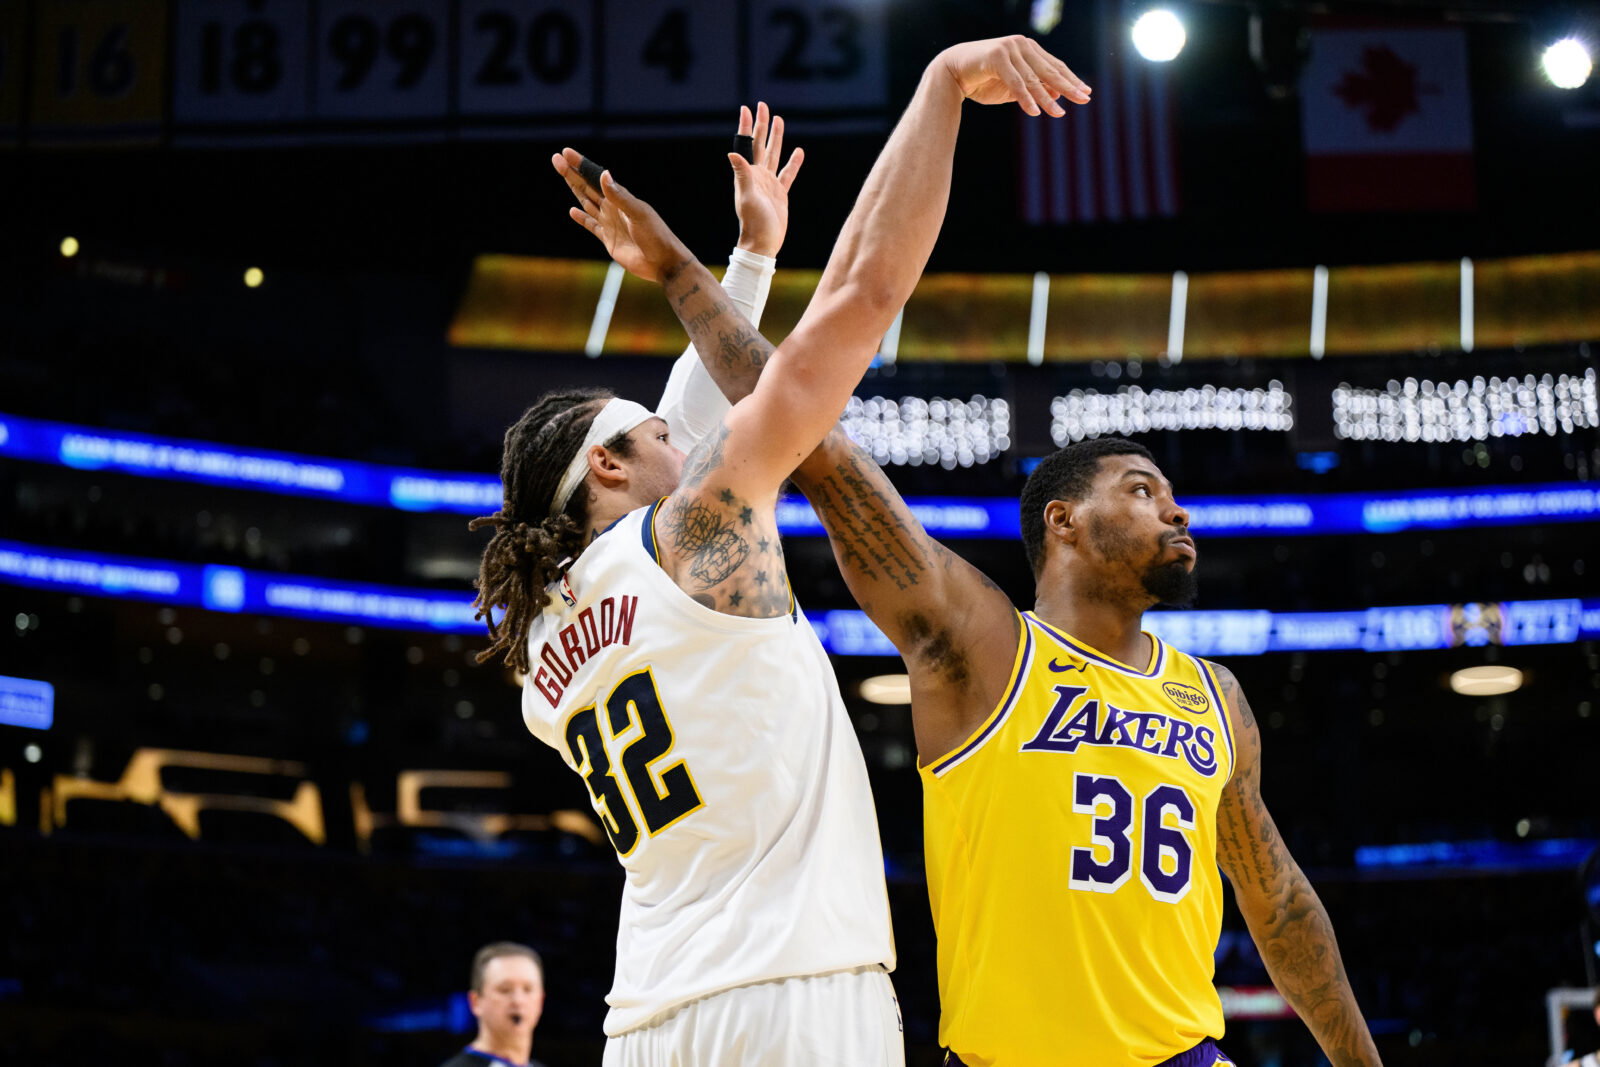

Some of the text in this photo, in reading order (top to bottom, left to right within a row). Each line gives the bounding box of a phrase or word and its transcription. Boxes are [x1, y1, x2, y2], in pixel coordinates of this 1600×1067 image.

[58, 26, 136, 98] 16
[201, 22, 282, 92] 18
[332, 15, 435, 90] 99
[474, 12, 579, 84] 20
[643, 10, 695, 81] 4
[766, 9, 862, 80] 23
[534, 594, 638, 709] GORDON
[1020, 685, 1218, 777] LAKERS
[1165, 686, 1206, 706] bibigo
[565, 665, 706, 858] 32
[1069, 771, 1196, 904] 36
